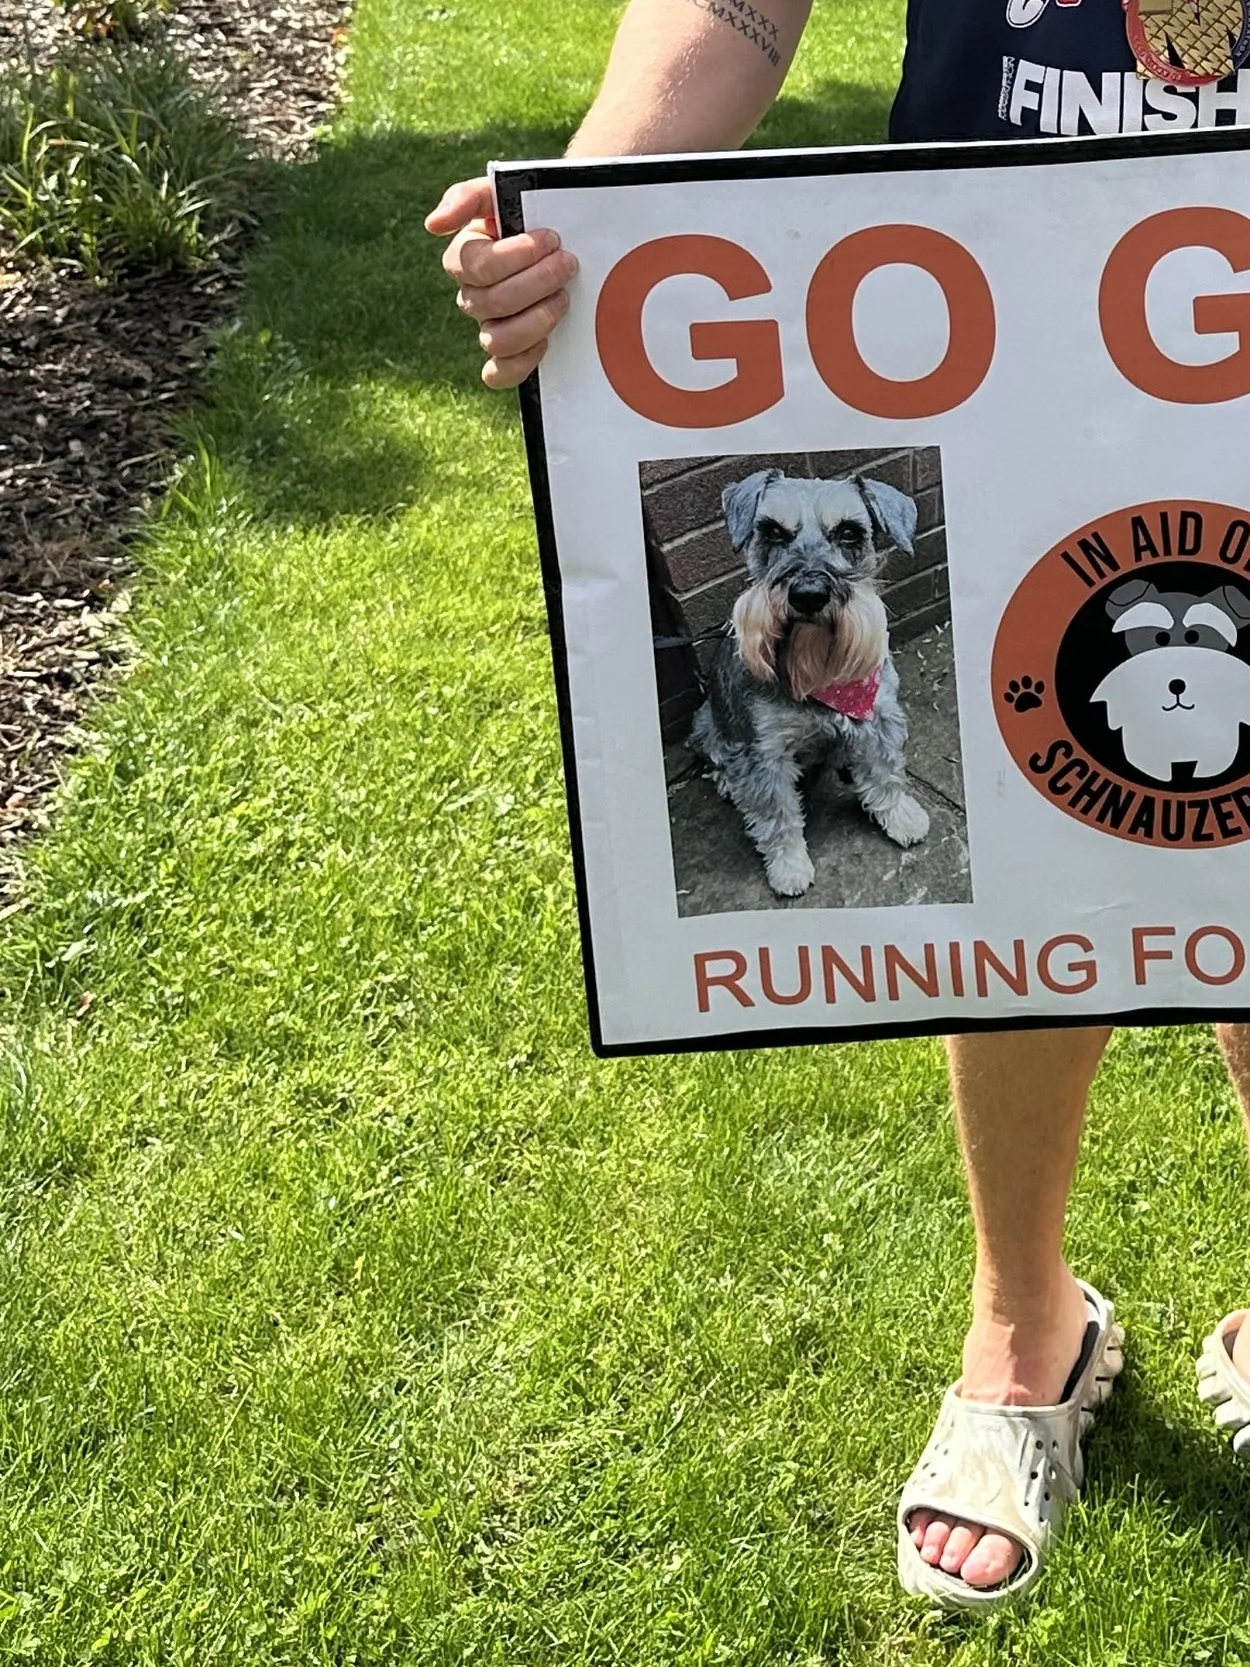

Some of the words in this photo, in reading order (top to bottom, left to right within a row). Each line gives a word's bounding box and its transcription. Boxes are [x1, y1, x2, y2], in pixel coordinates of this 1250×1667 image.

[595, 224, 996, 429] GO
[1060, 531, 1121, 588] IN
[1130, 510, 1204, 563] AID
[694, 934, 1097, 1012] RUNNING
